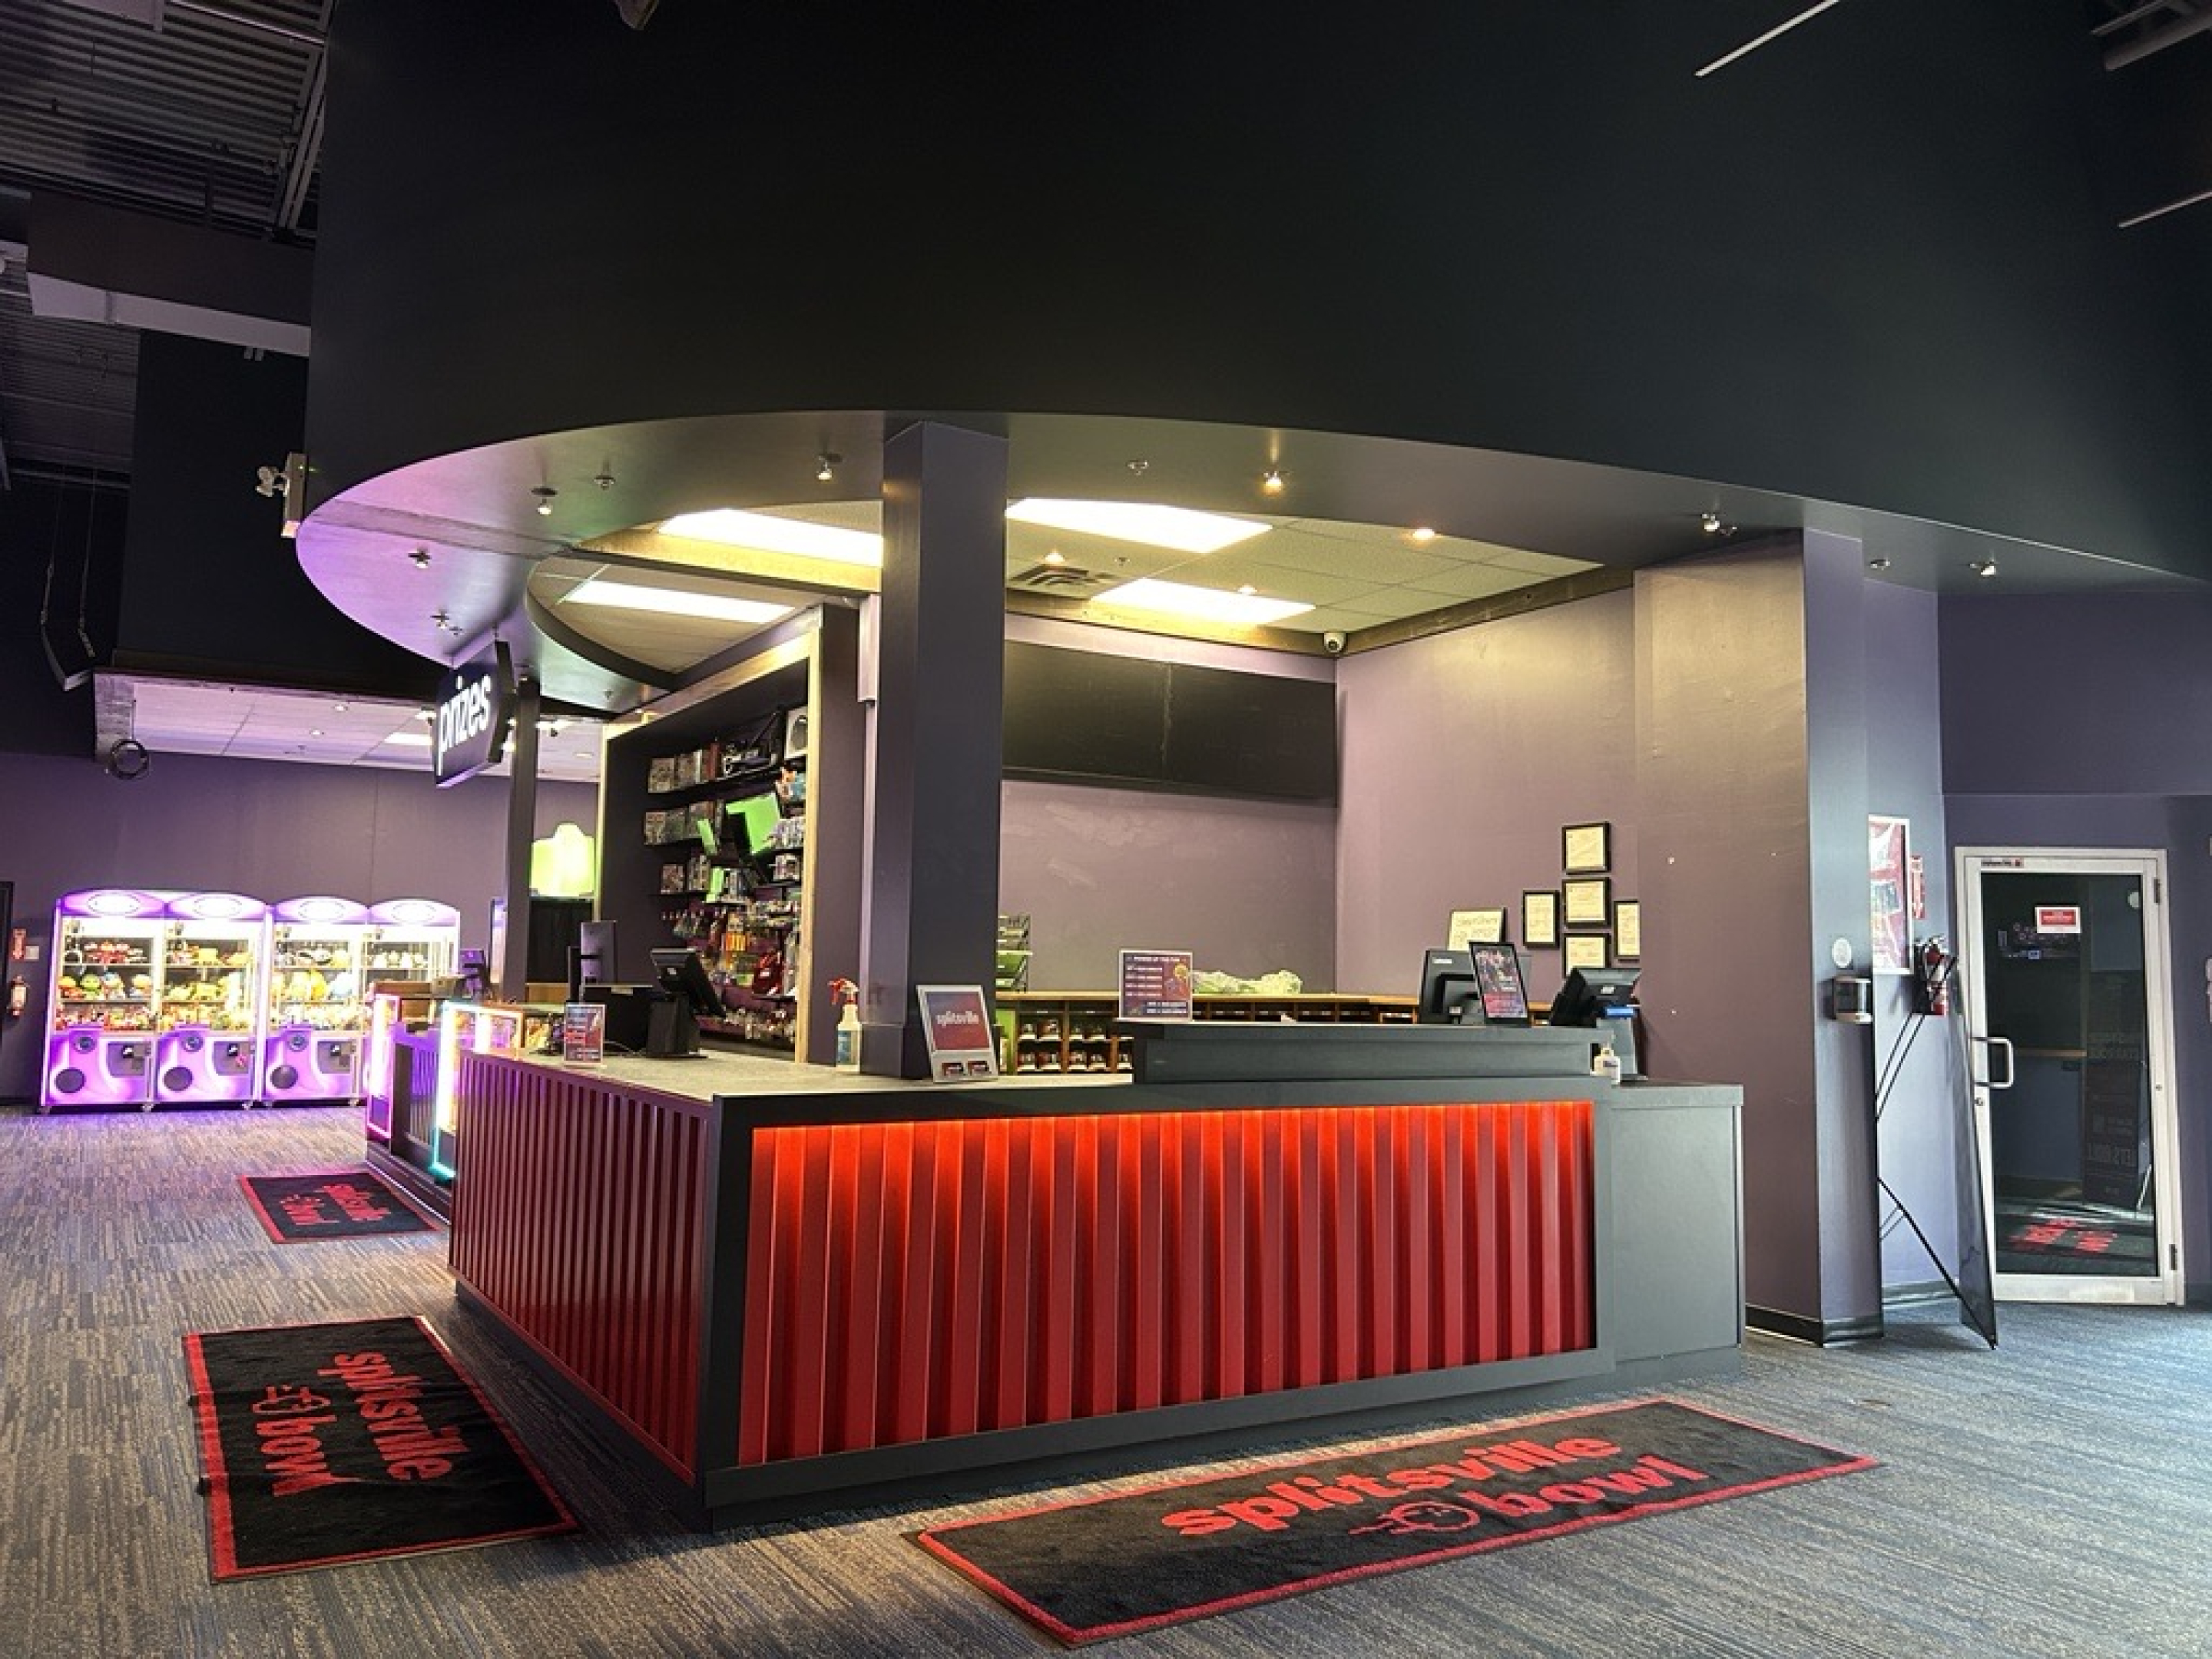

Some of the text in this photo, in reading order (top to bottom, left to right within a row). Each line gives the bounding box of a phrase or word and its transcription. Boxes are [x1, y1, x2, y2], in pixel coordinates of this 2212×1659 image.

[438, 674, 491, 776] prizes
[935, 1010, 979, 1027] splitsville
[256, 1415, 367, 1497] bowl
[318, 1353, 469, 1480] splitsville
[1161, 1437, 1621, 1535] splitsville
[1460, 1455, 1708, 1517] bowl
